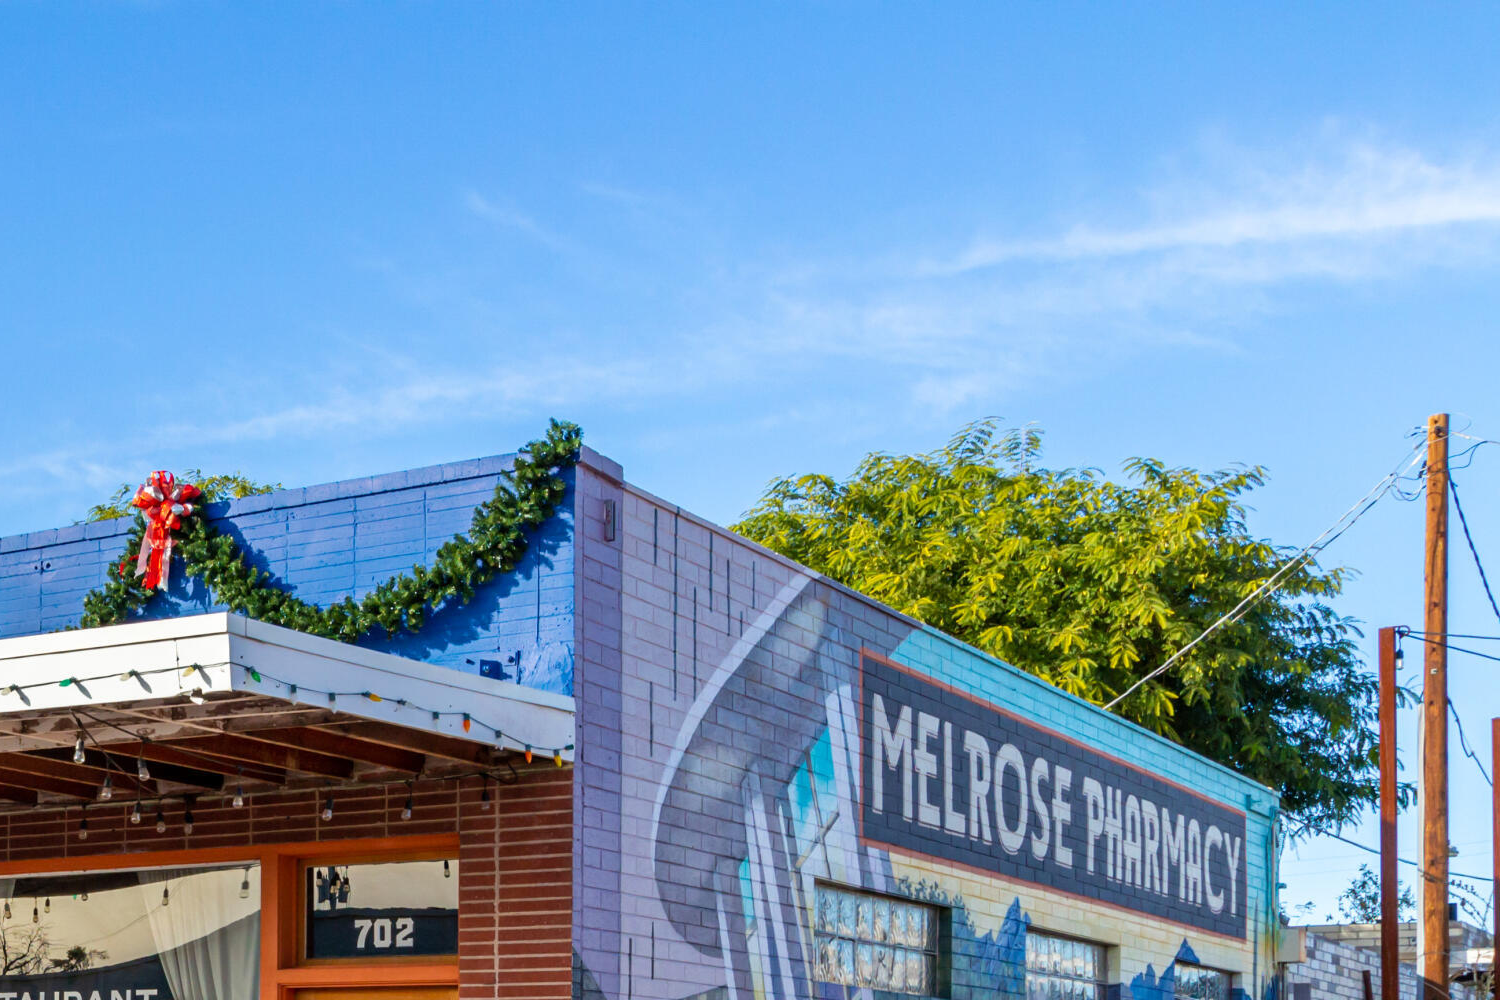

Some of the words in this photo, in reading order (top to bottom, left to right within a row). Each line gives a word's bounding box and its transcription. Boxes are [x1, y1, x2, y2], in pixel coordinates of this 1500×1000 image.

[871, 692, 1074, 869] MELROSE
[1082, 776, 1241, 918] PHARMACY
[354, 917, 414, 949] 702
